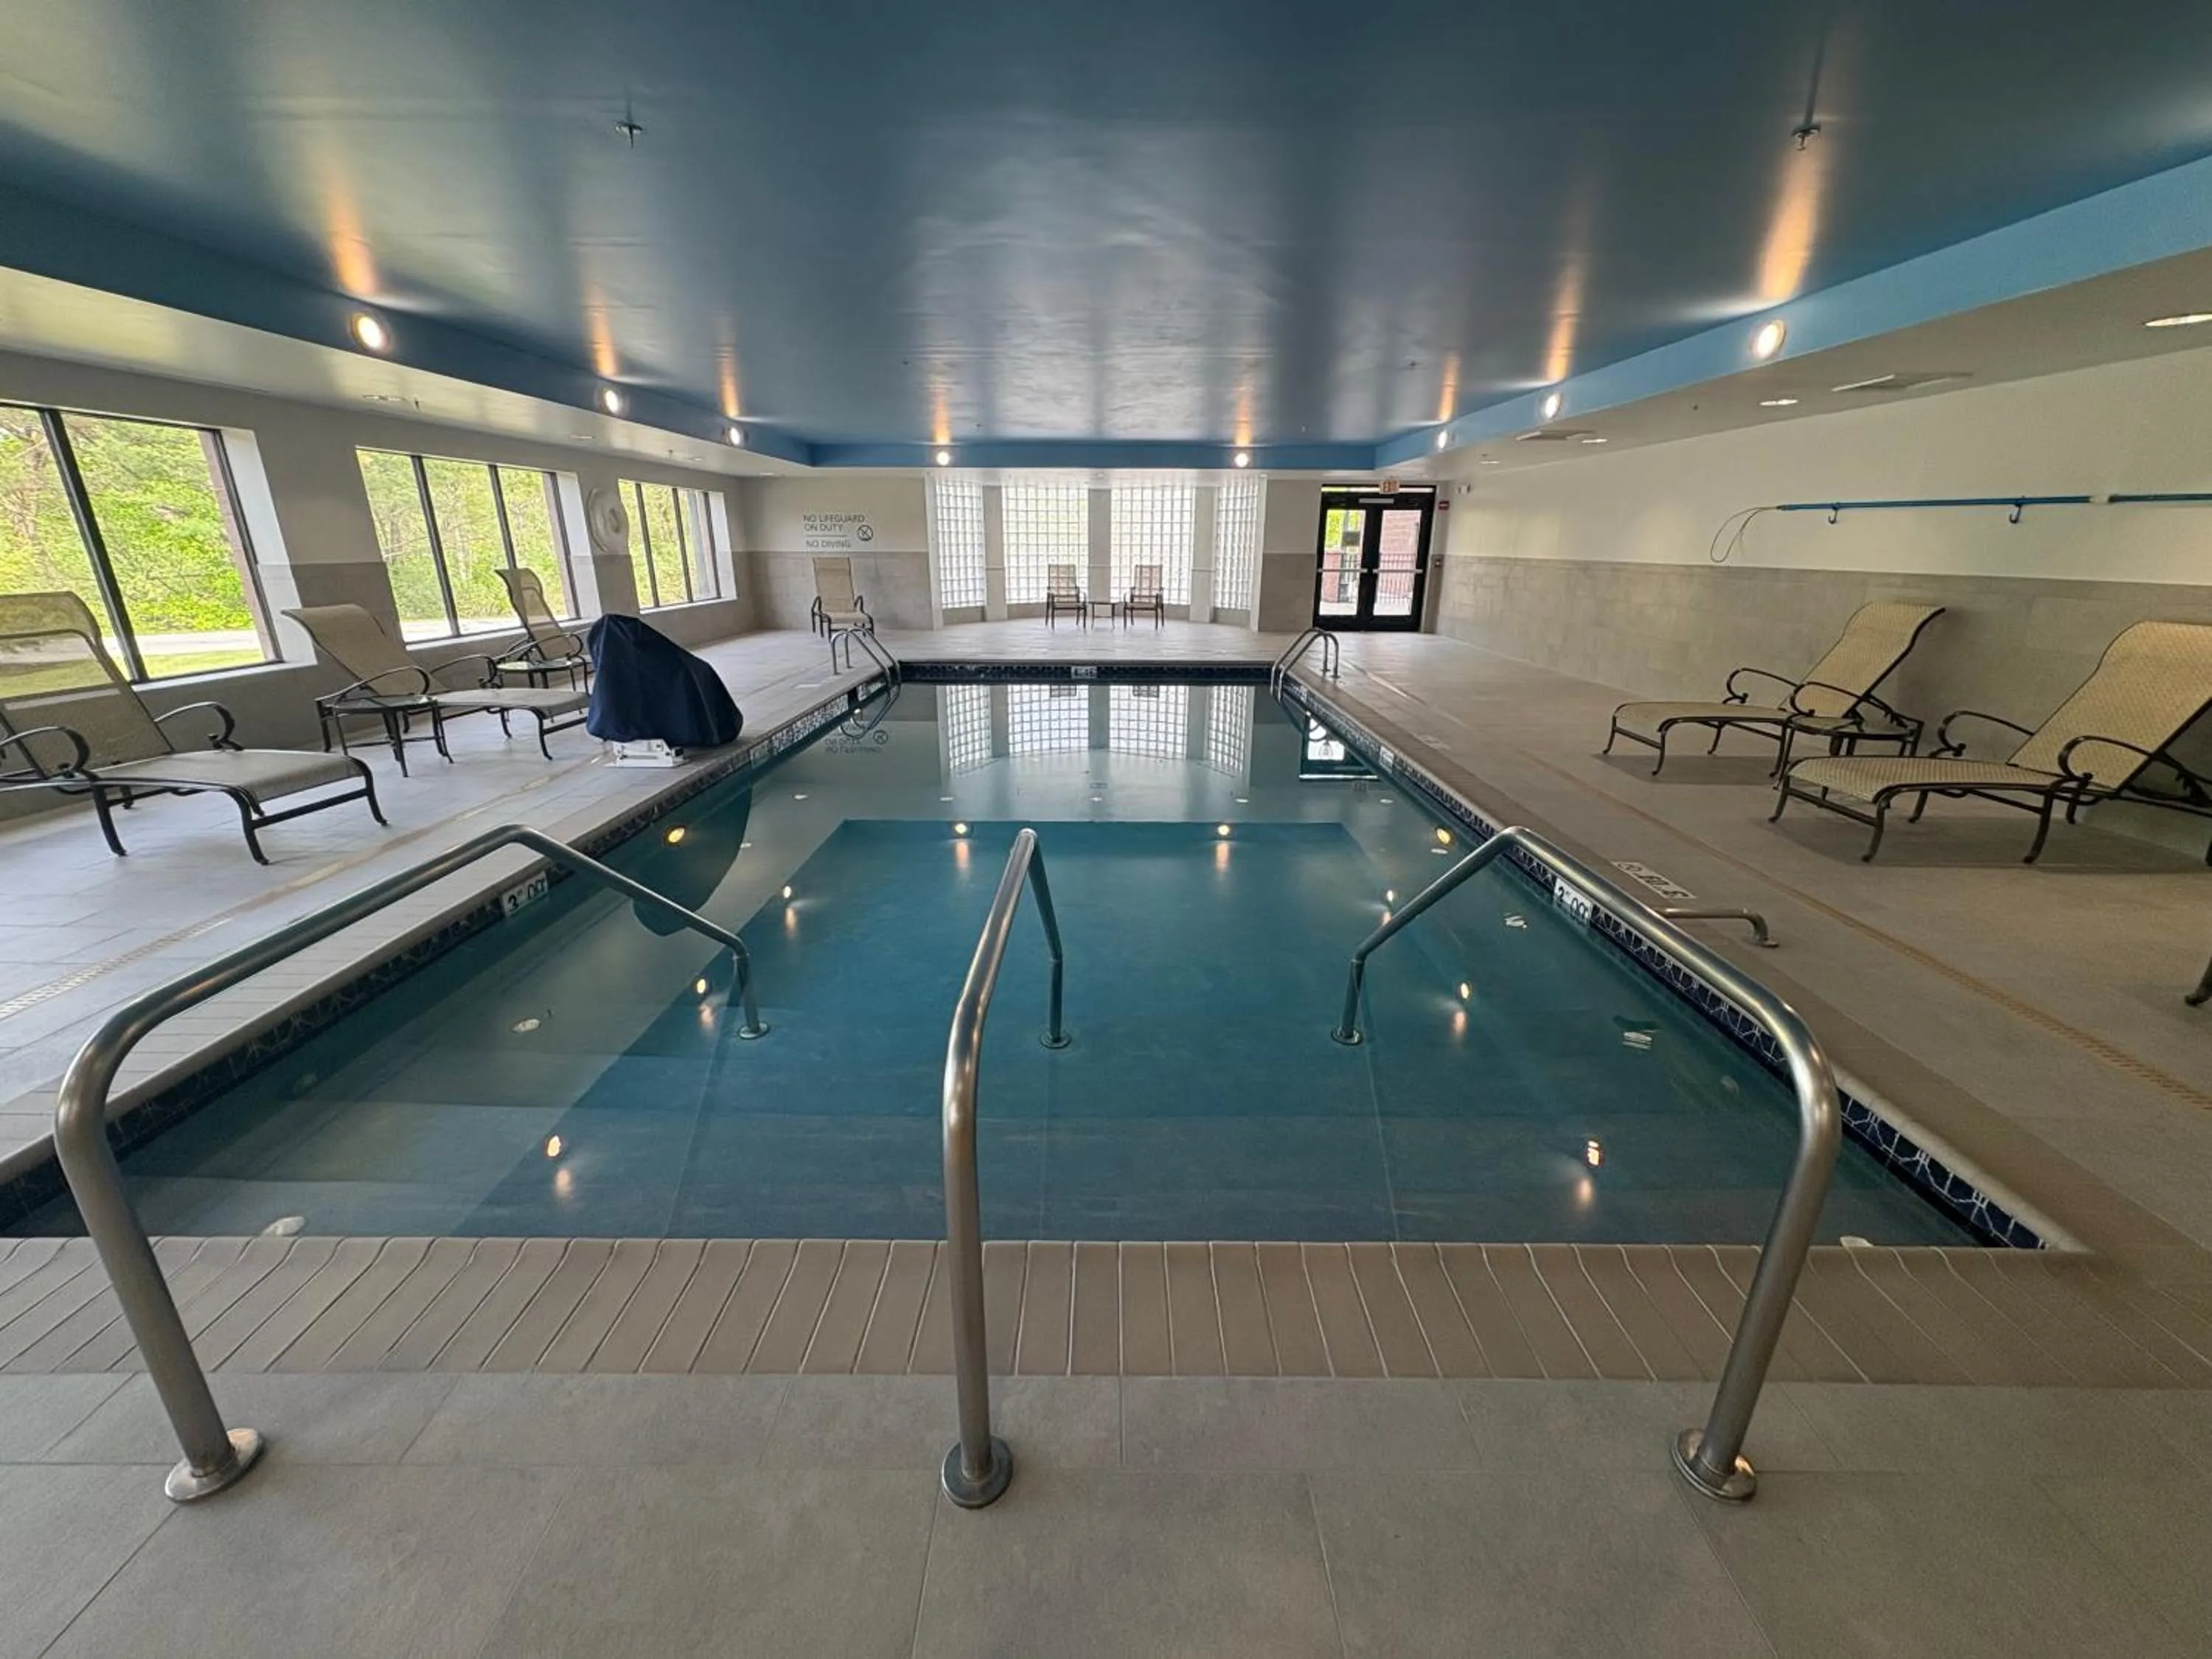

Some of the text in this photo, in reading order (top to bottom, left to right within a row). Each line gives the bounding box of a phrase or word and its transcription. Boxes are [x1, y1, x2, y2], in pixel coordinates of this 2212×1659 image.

[818, 514, 866, 523] LIFEGUARD
[804, 523, 844, 532] ON DUTY
[806, 539, 851, 549] NO DIVING
